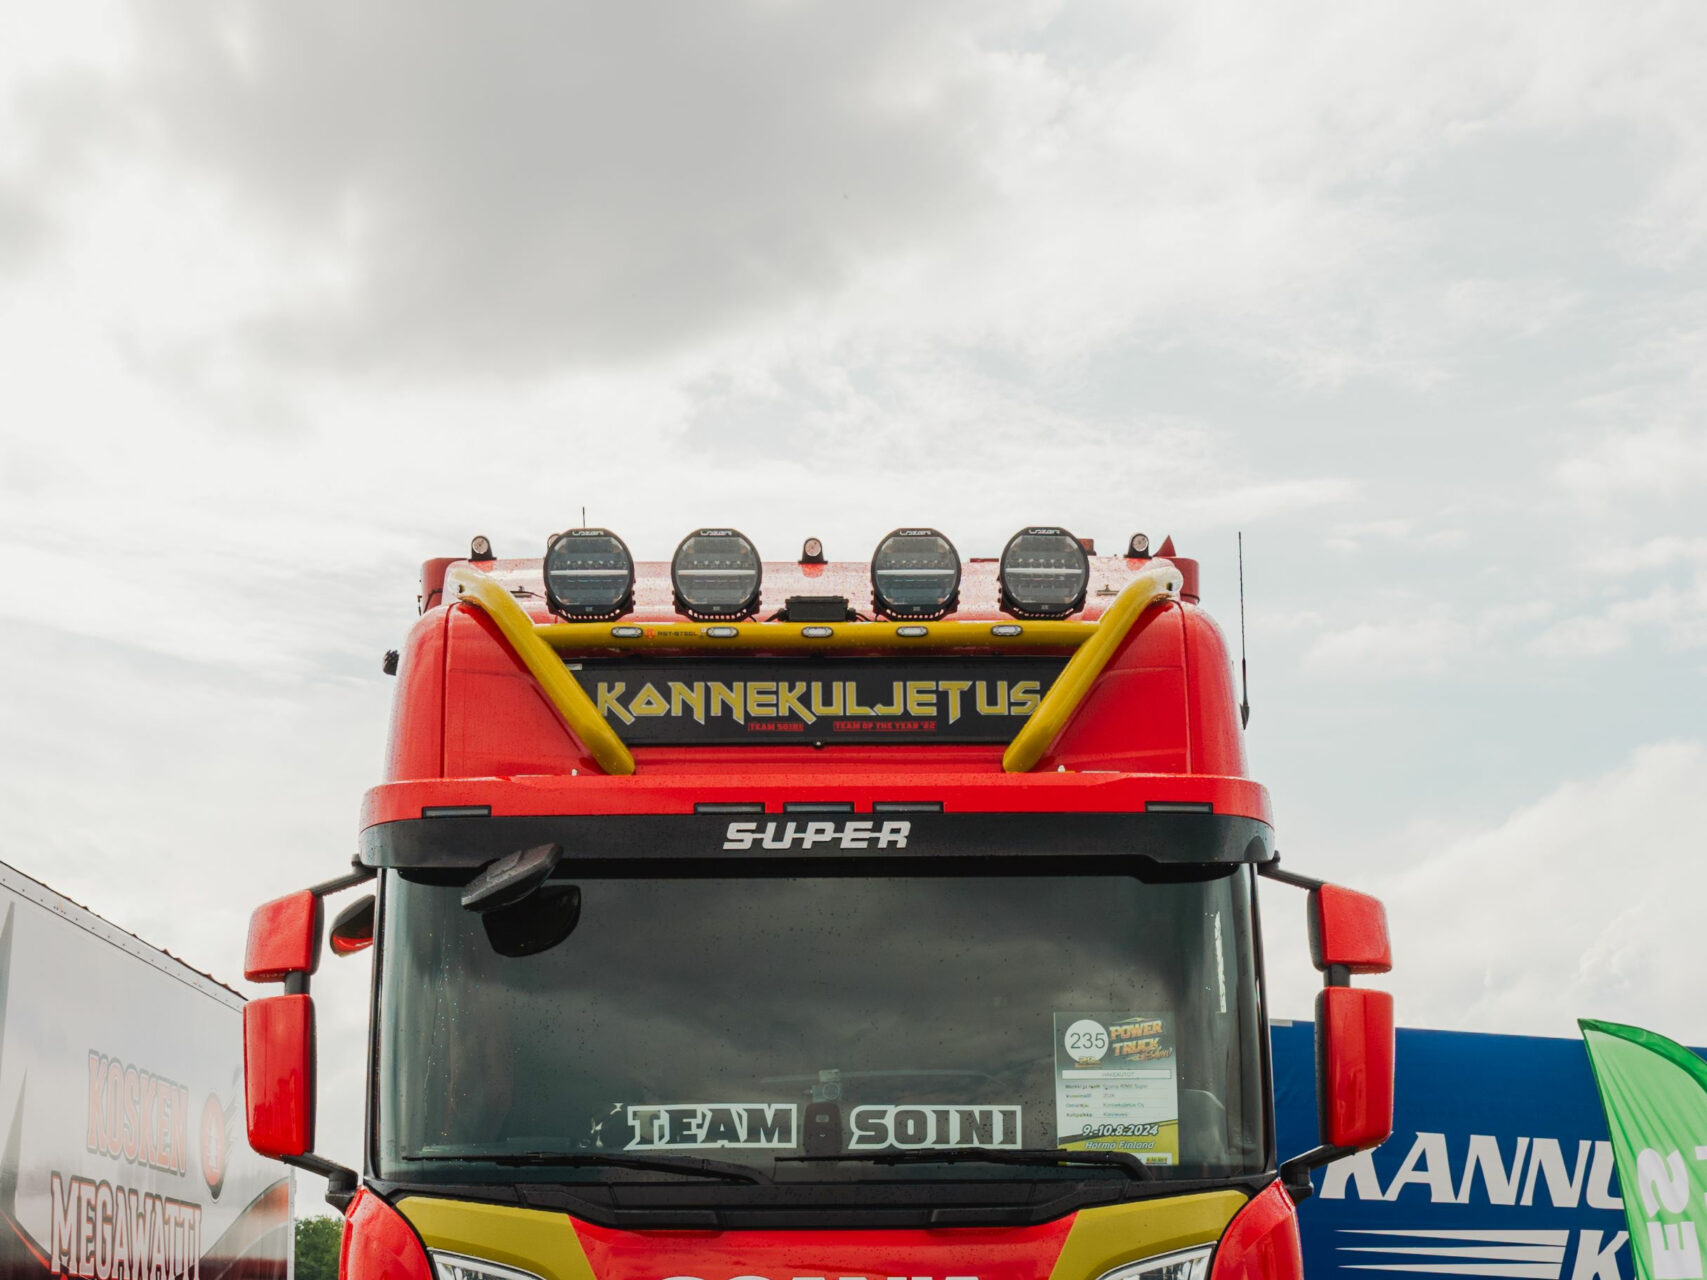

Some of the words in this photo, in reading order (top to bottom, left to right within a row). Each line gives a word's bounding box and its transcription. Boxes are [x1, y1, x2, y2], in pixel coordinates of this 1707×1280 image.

[596, 679, 1042, 725] KANNEKULJETUS
[722, 821, 912, 850] SUPER
[1070, 1032, 1106, 1049] 235
[1109, 1020, 1163, 1041] POWER
[1112, 1037, 1161, 1057] TRUCK
[86, 1048, 190, 1178] KOSKEN
[623, 1102, 798, 1151] TEAM
[848, 1104, 1022, 1150] SOINI
[1082, 1123, 1160, 1137] 9.-10.8.2024
[1118, 1140, 1156, 1150] Finland
